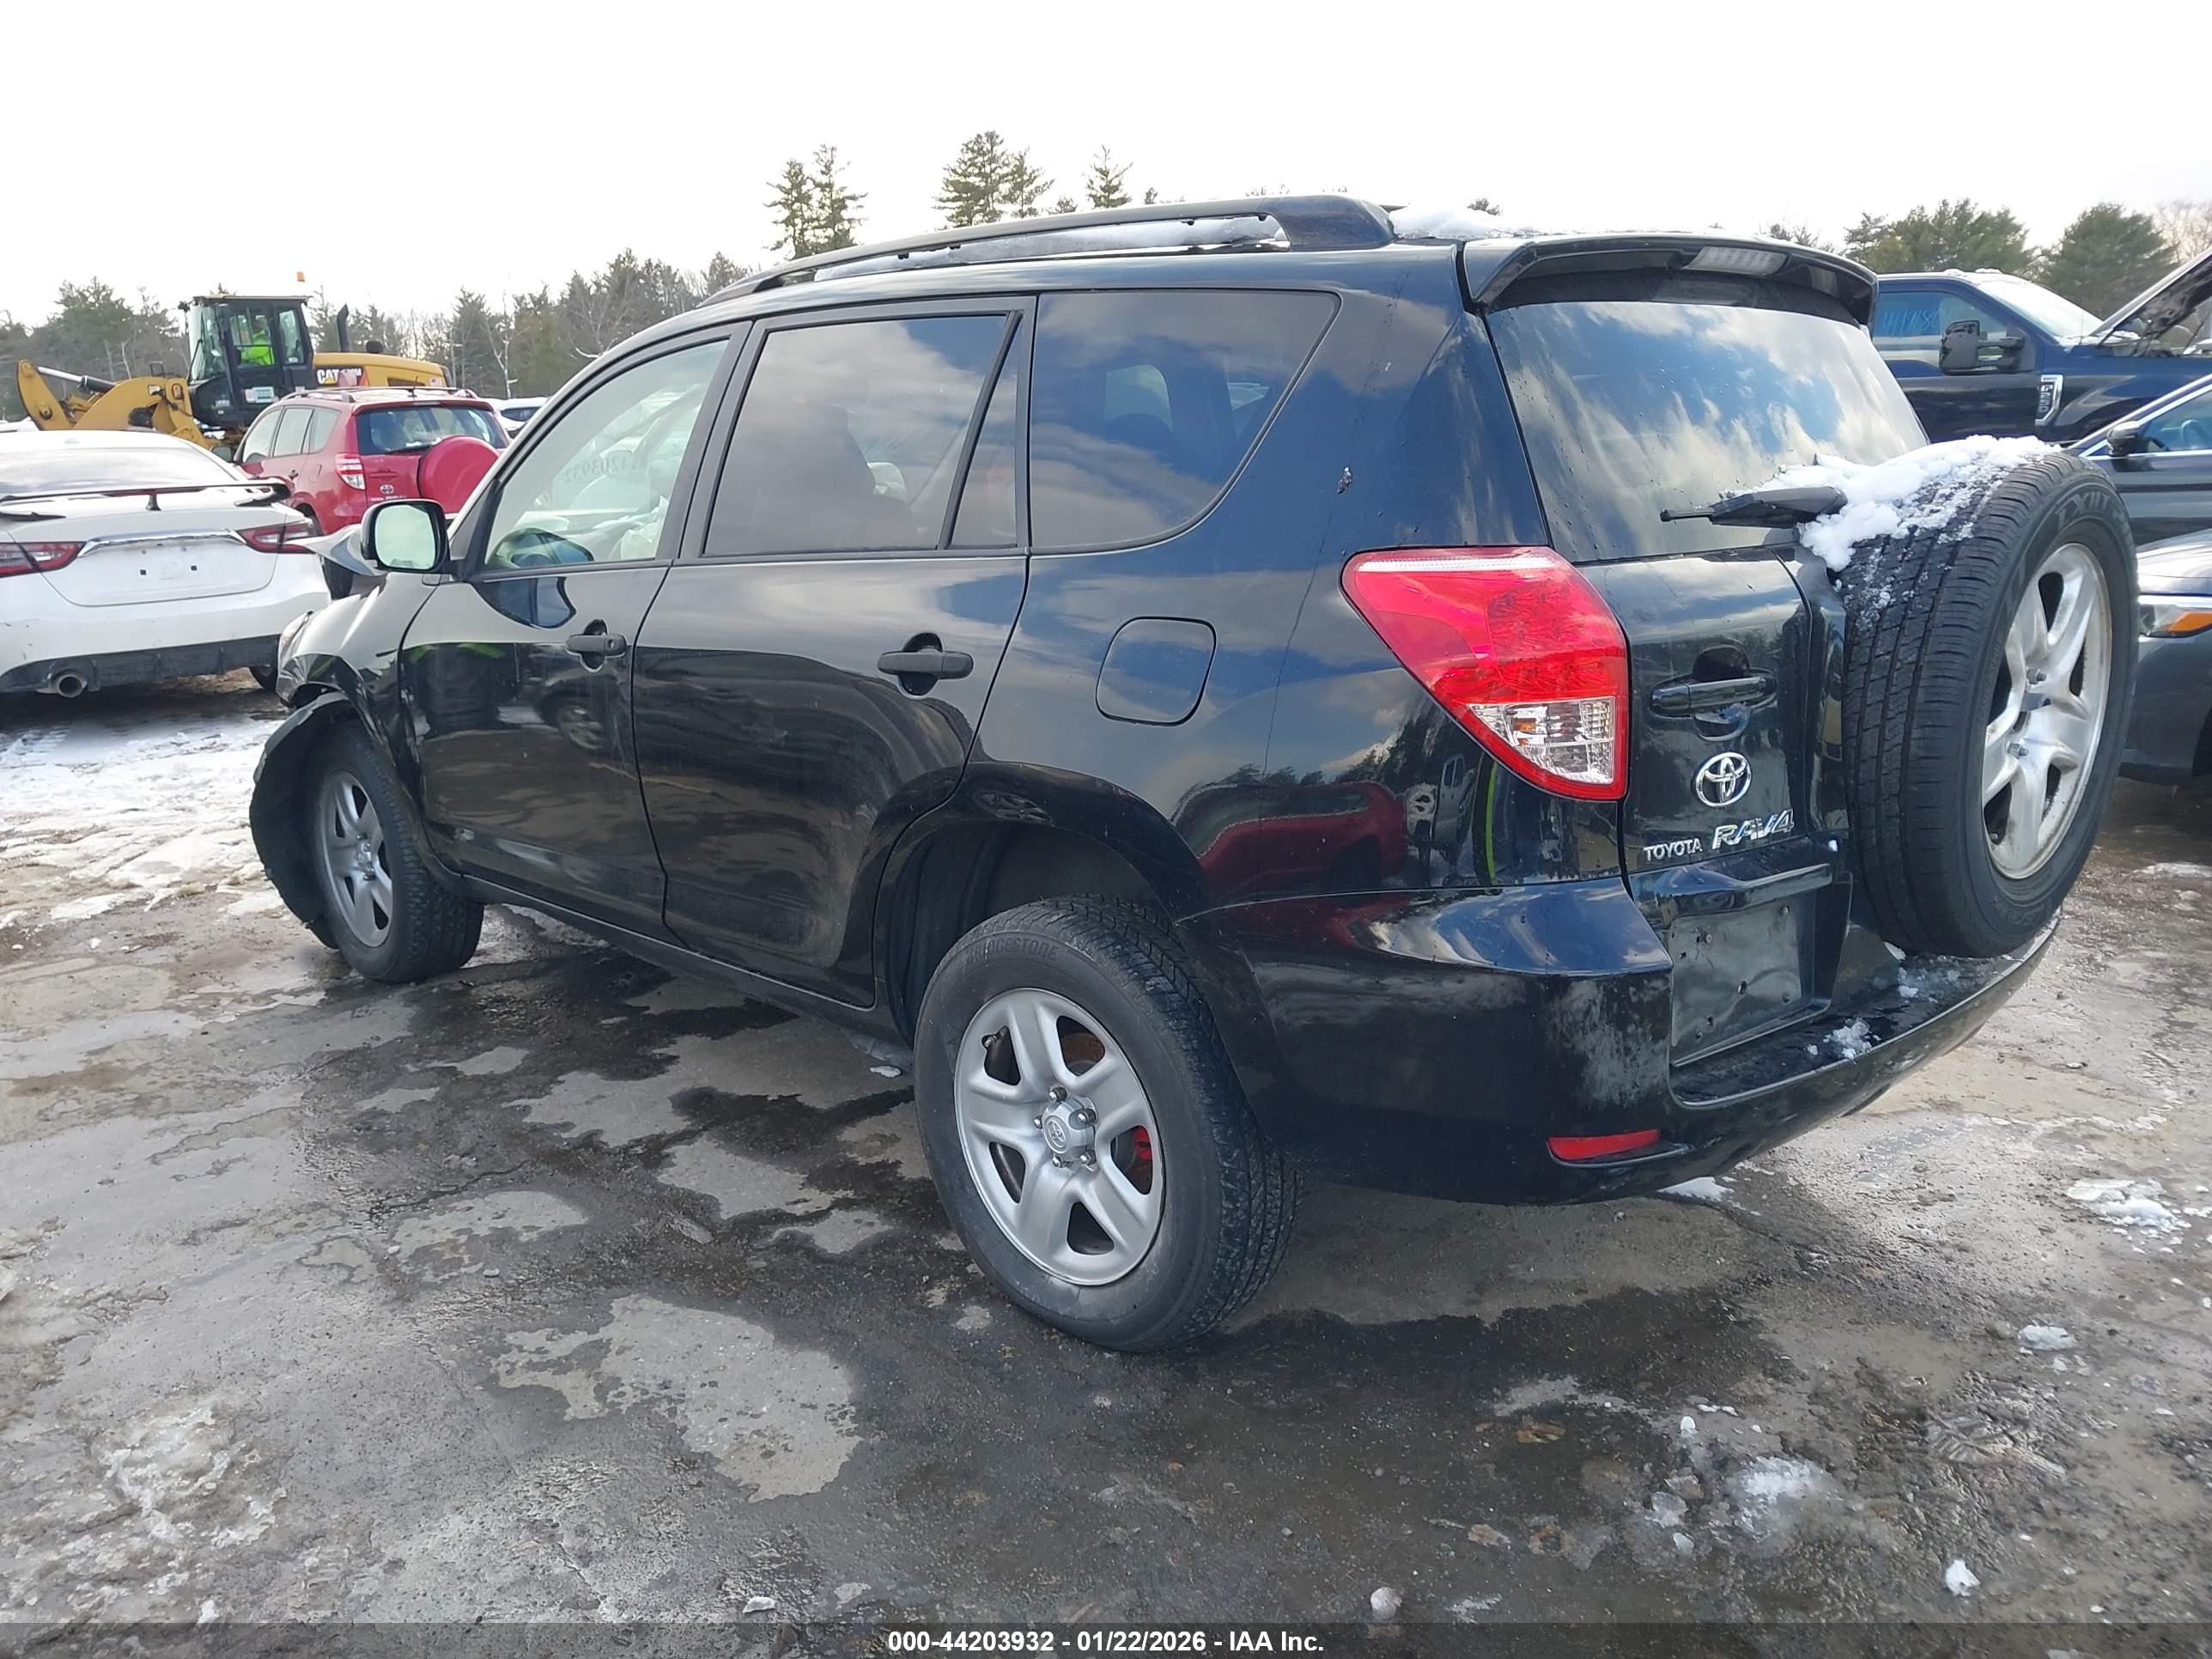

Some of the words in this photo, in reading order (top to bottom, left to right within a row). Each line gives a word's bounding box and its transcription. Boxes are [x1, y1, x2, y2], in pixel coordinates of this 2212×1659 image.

[317, 369, 339, 385] CAT
[1644, 838, 1703, 861] TOYOTA
[1712, 809, 1795, 850] RAV4
